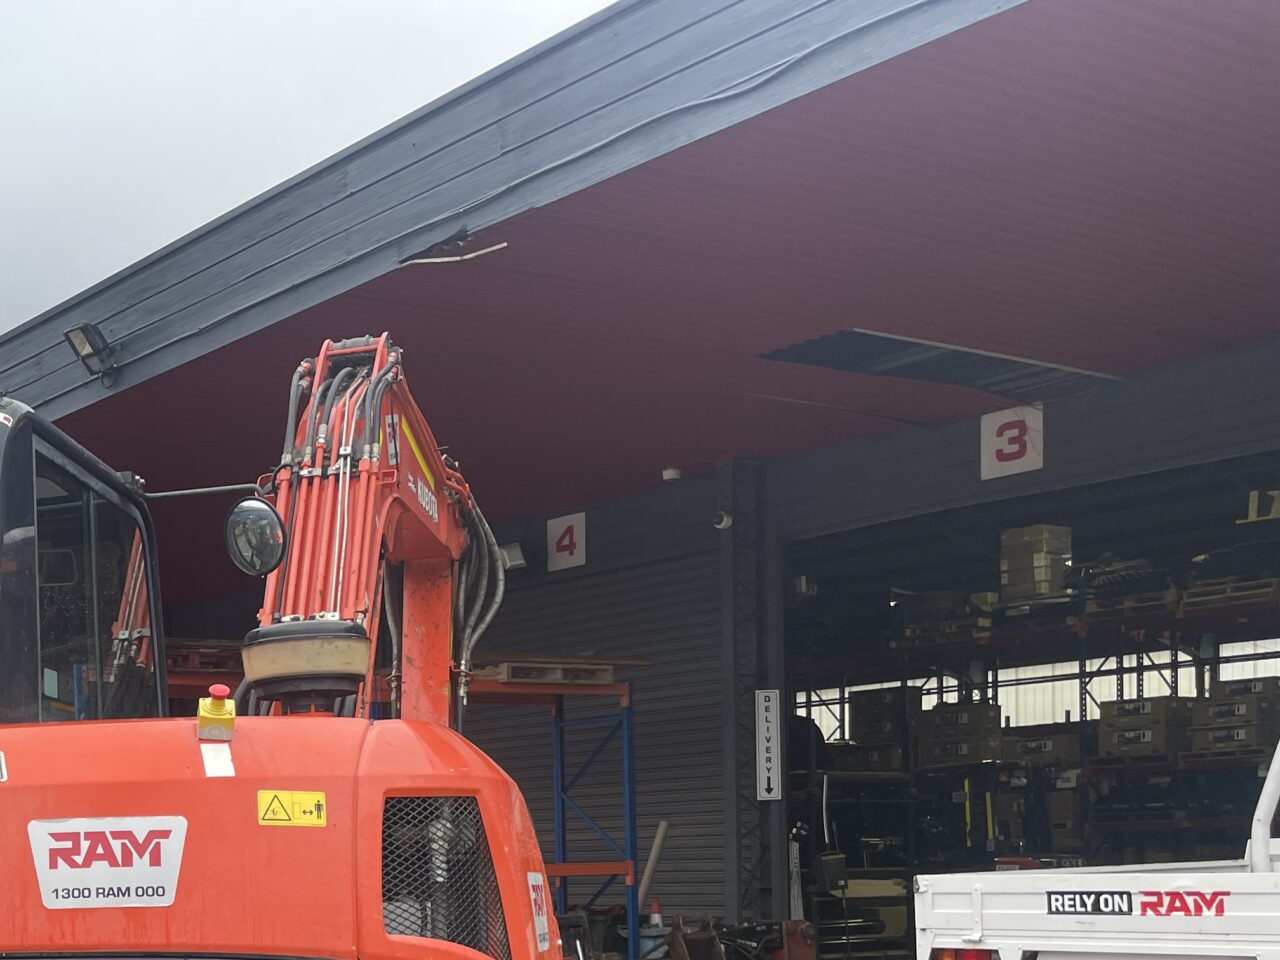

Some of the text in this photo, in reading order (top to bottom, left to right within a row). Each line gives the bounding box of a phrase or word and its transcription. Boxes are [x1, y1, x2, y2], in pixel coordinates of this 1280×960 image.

[995, 419, 1027, 463] 3
[555, 524, 577, 557] 4
[763, 695, 772, 774] DELIVERY
[46, 829, 173, 870] RAM
[51, 885, 166, 900] 1300 RAM 000
[1050, 890, 1232, 917] RELY ON RAM
